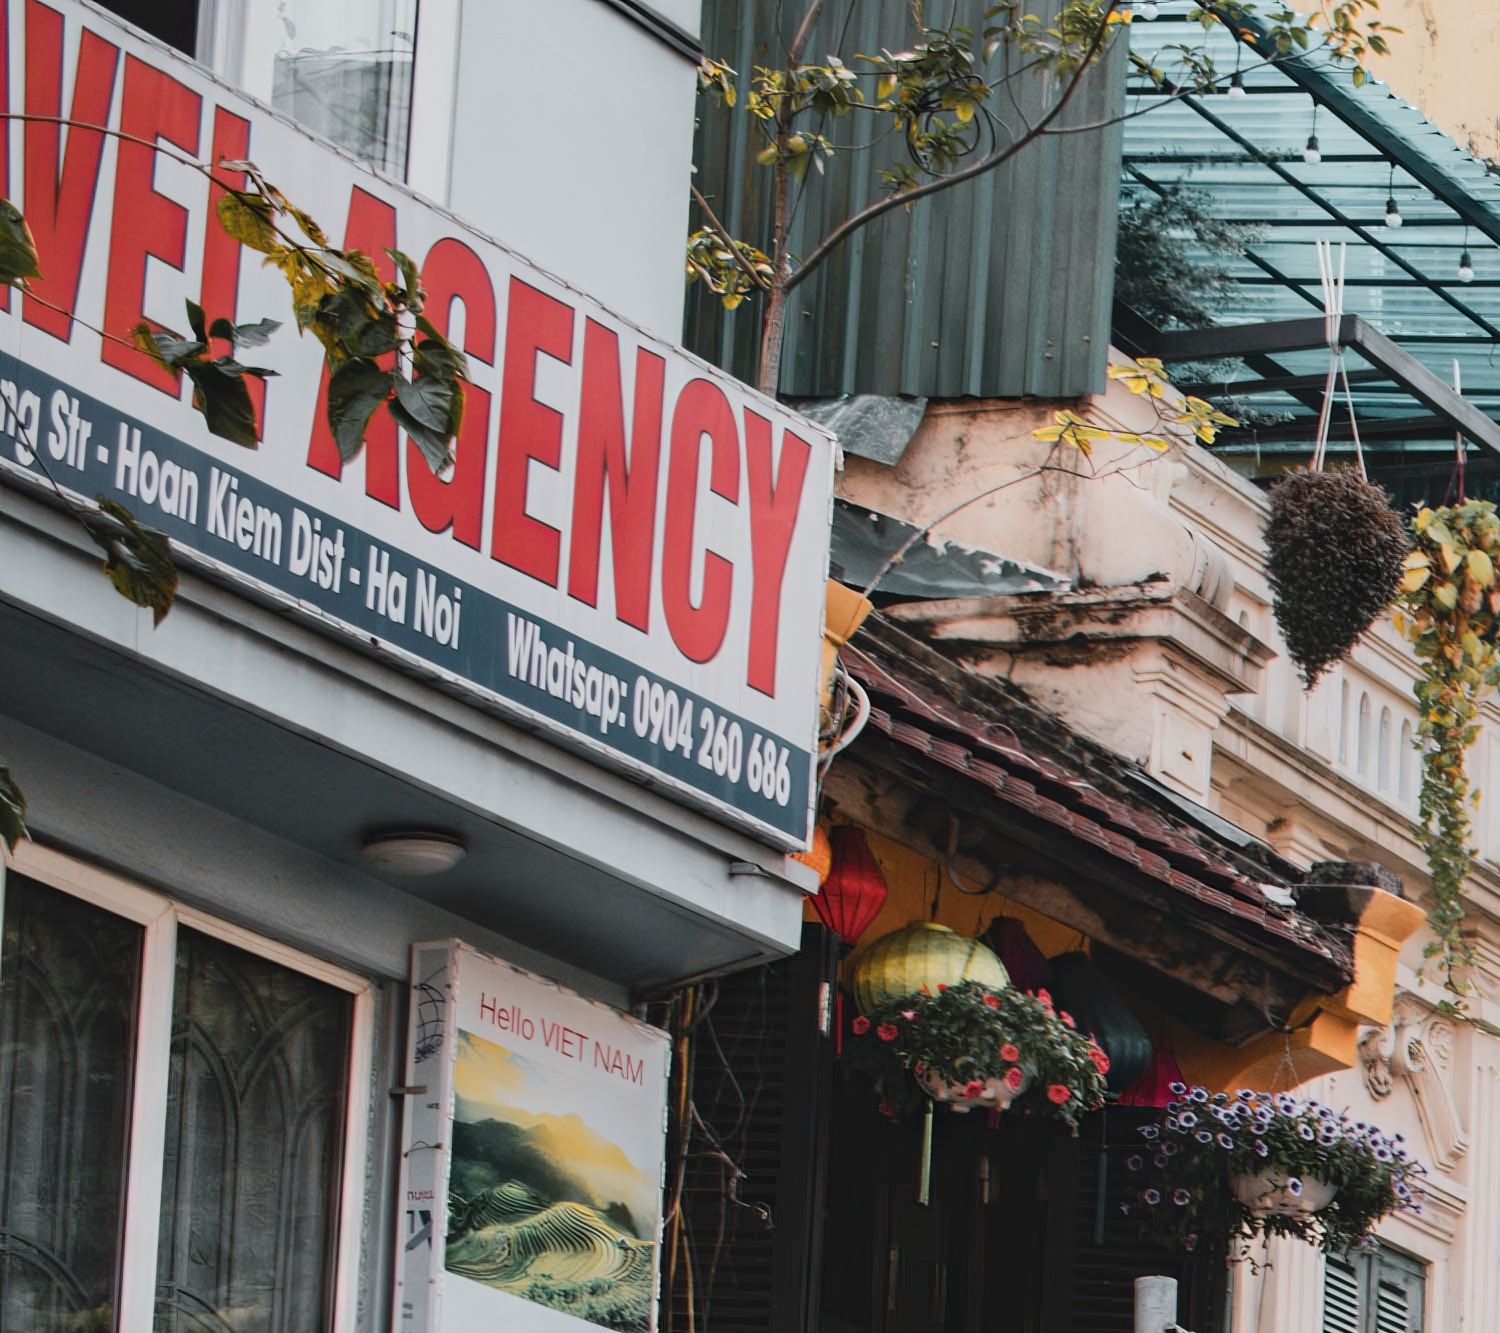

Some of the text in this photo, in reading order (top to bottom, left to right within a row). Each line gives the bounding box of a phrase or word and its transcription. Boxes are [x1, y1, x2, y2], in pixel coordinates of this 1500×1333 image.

[0, 0, 811, 698] VEL AGENCY
[49, 389, 92, 471] Str
[114, 422, 198, 525] Hoan
[207, 467, 282, 566] Kiem
[289, 508, 344, 593] Dist
[365, 544, 407, 624] Ha
[414, 568, 462, 651] Noi
[508, 613, 626, 732] Whatsap:
[633, 674, 693, 760] 0904
[698, 705, 742, 784] 260
[747, 728, 791, 808] 686
[480, 992, 644, 1087] Hello VIET NAM
